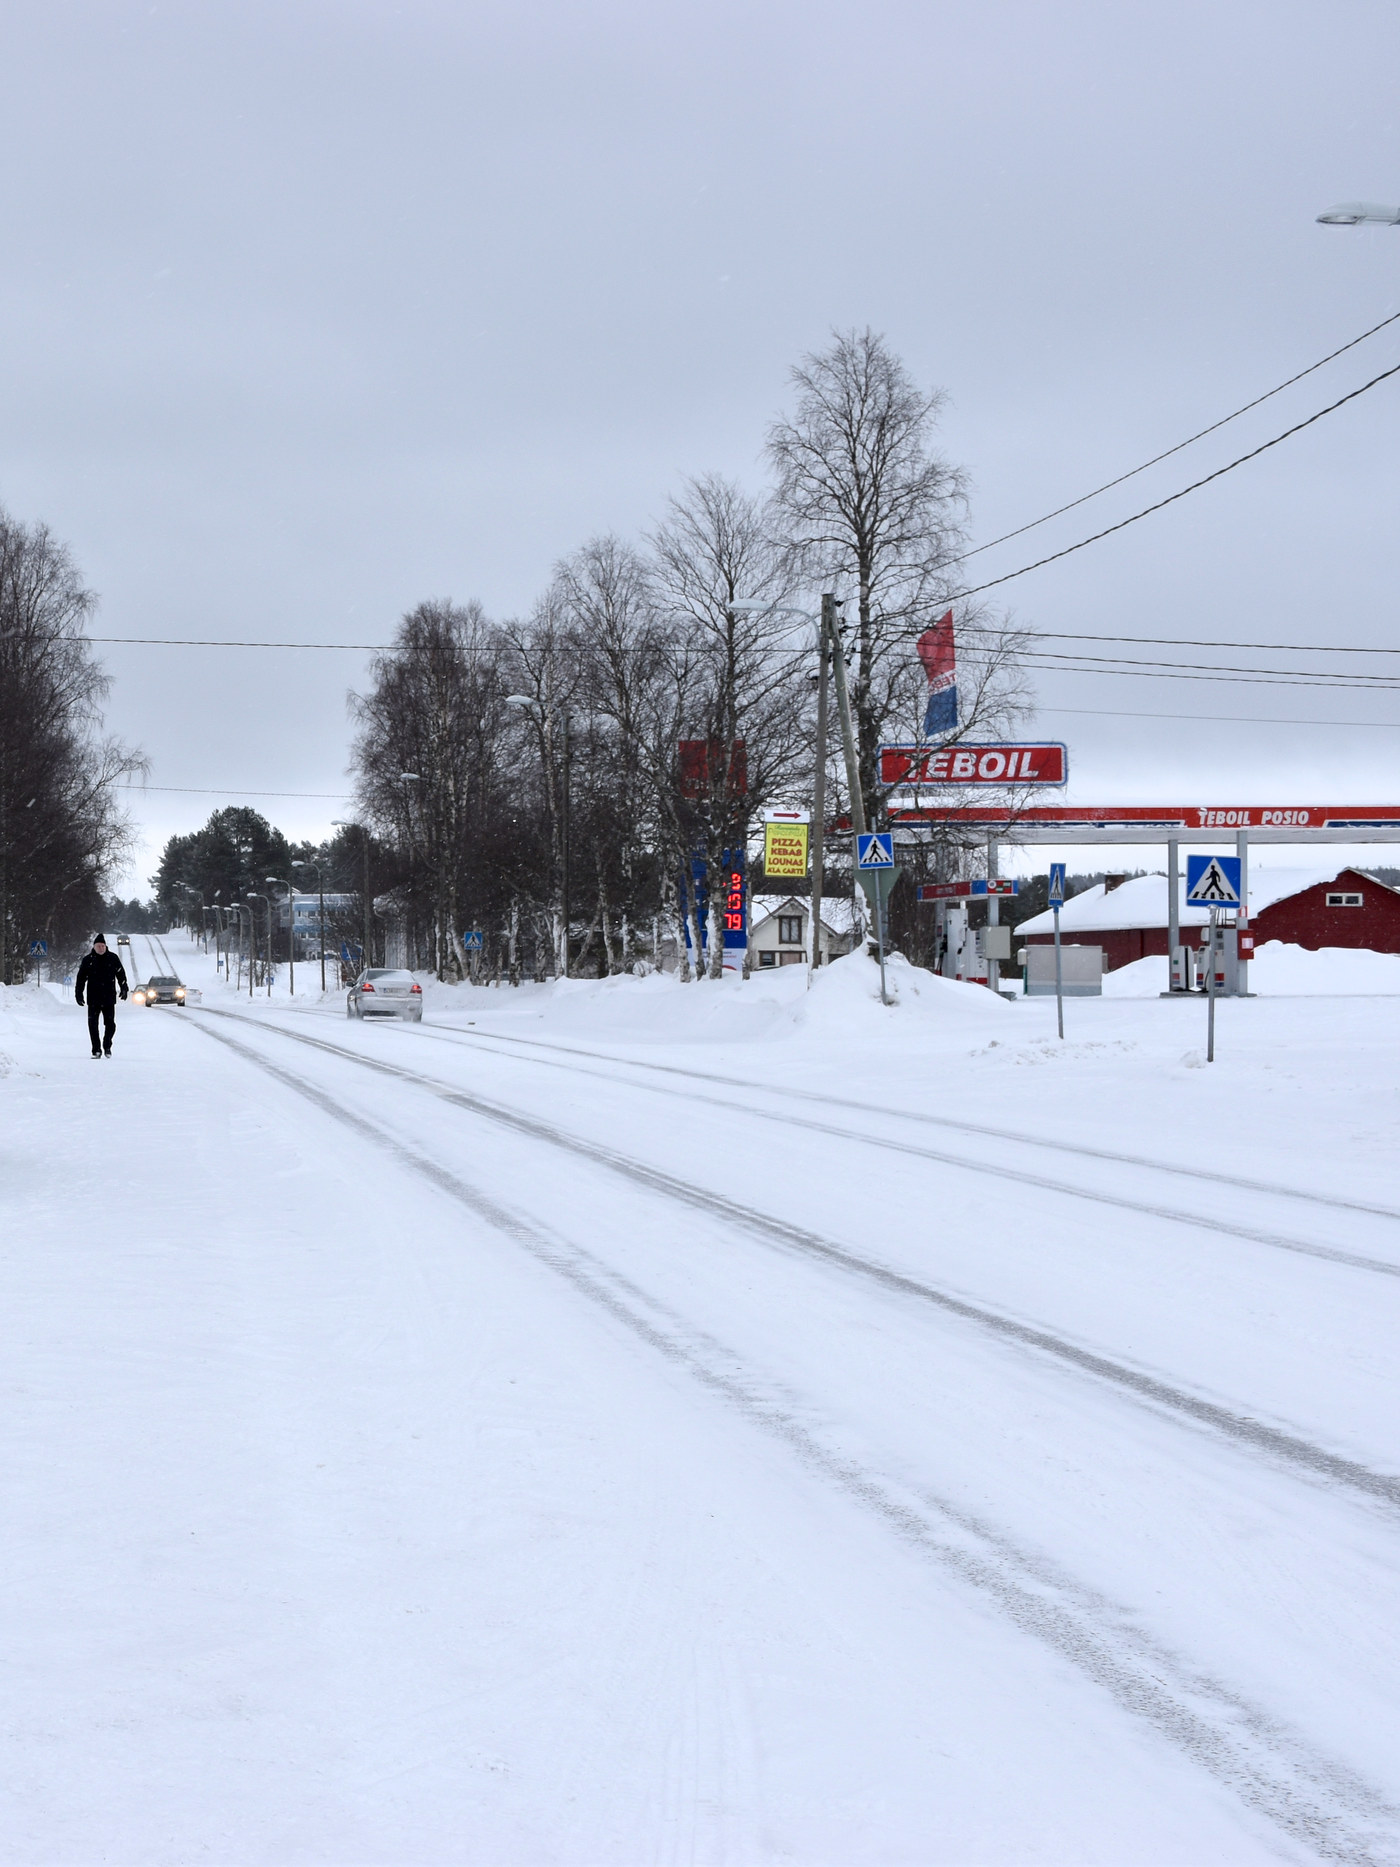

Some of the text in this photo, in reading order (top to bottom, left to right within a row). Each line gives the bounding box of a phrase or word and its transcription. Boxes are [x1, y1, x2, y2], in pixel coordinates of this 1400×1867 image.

[903, 751, 1039, 779] TEBOIL
[1197, 810, 1310, 825] TEBOIL POSIO
[771, 838, 803, 847] PIZZA
[770, 848, 802, 856] KEBAB
[768, 857, 804, 866] LOUNAS
